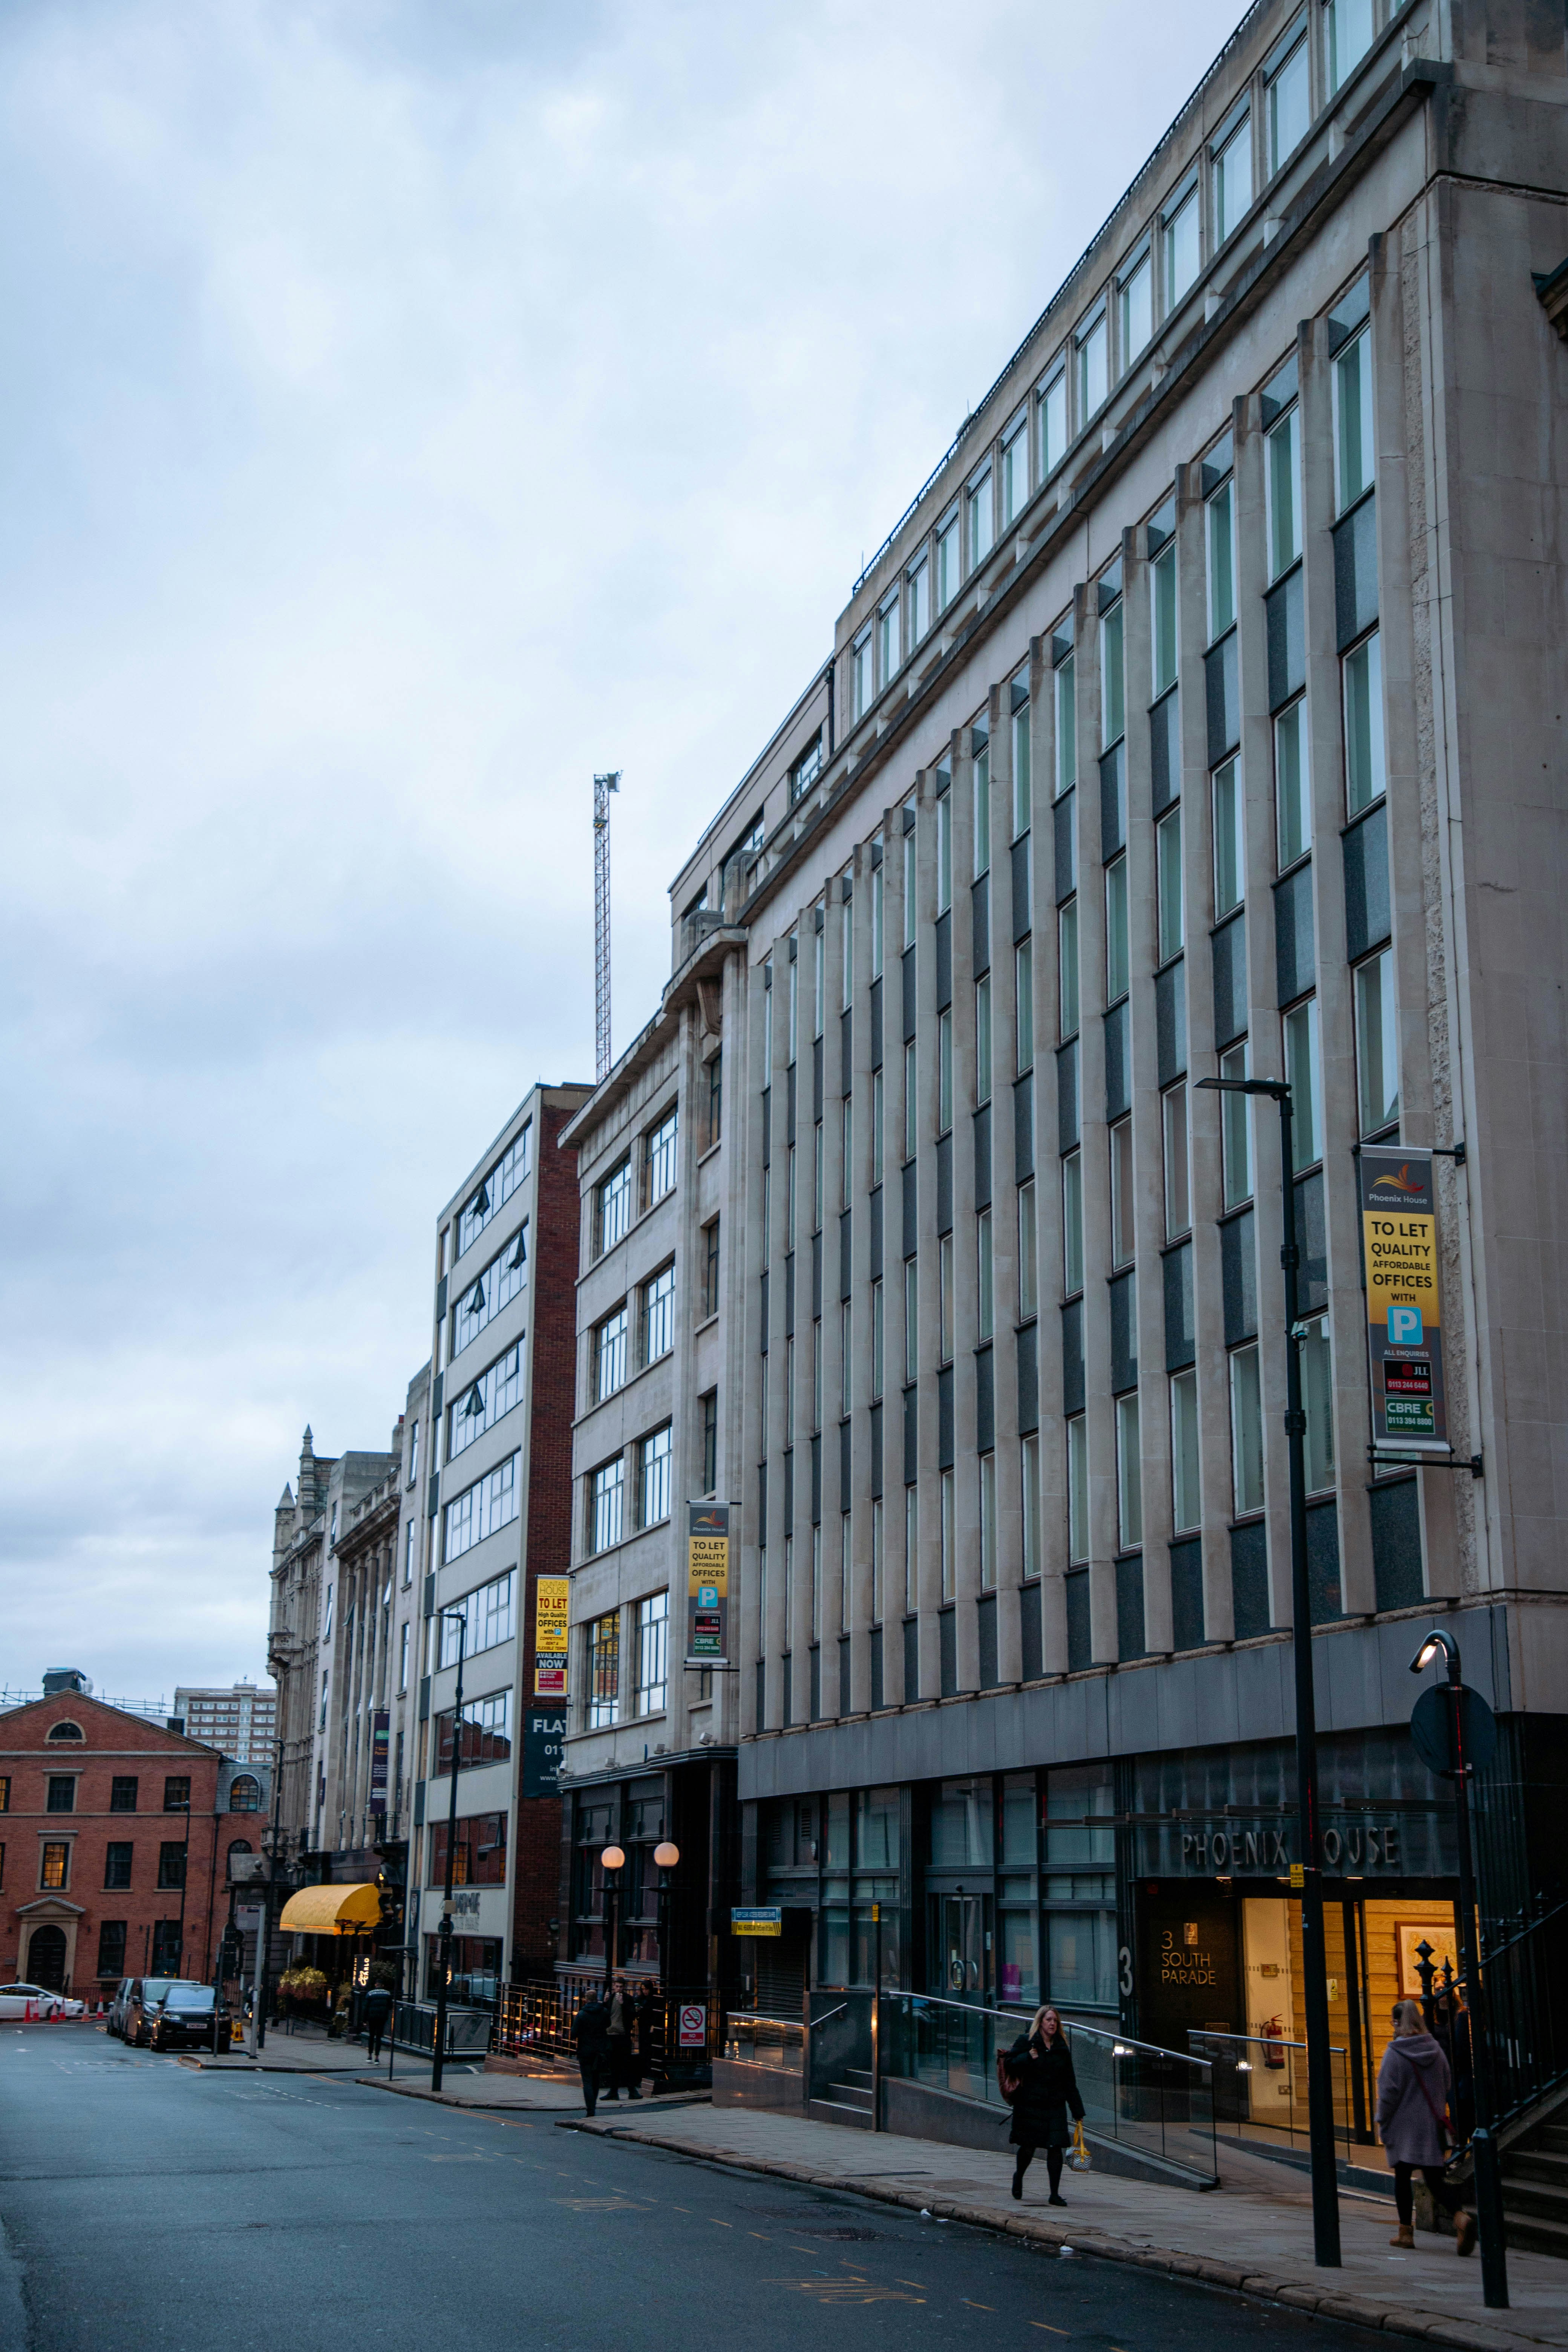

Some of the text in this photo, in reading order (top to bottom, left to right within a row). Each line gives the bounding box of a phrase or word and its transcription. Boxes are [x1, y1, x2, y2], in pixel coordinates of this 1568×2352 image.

[1369, 1194, 1402, 1202] Phoenix
[1371, 1221, 1428, 1237] TO LET
[1371, 1243, 1430, 1257] QUALITY
[1373, 1260, 1430, 1270] AFFORDABLE
[1373, 1274, 1432, 1288] OFFICES
[1391, 1293, 1416, 1302] WITH
[1393, 1309, 1417, 1341] P
[1413, 1366, 1429, 1375] JLL
[1387, 1403, 1421, 1413] CBRE
[540, 1586, 567, 1595] HOUSE
[701, 1588, 715, 1606] P
[539, 1598, 567, 1609] TO LET
[539, 1659, 564, 1668] NOW
[1182, 1827, 1397, 1865] PHOENIX OUSE
[1161, 1931, 1173, 1949] 3
[1161, 1952, 1210, 1967] SOUTH
[1119, 1946, 1133, 1996] 3
[1162, 1970, 1216, 1984] PARADE
[761, 2276, 928, 2304] TAXIS
